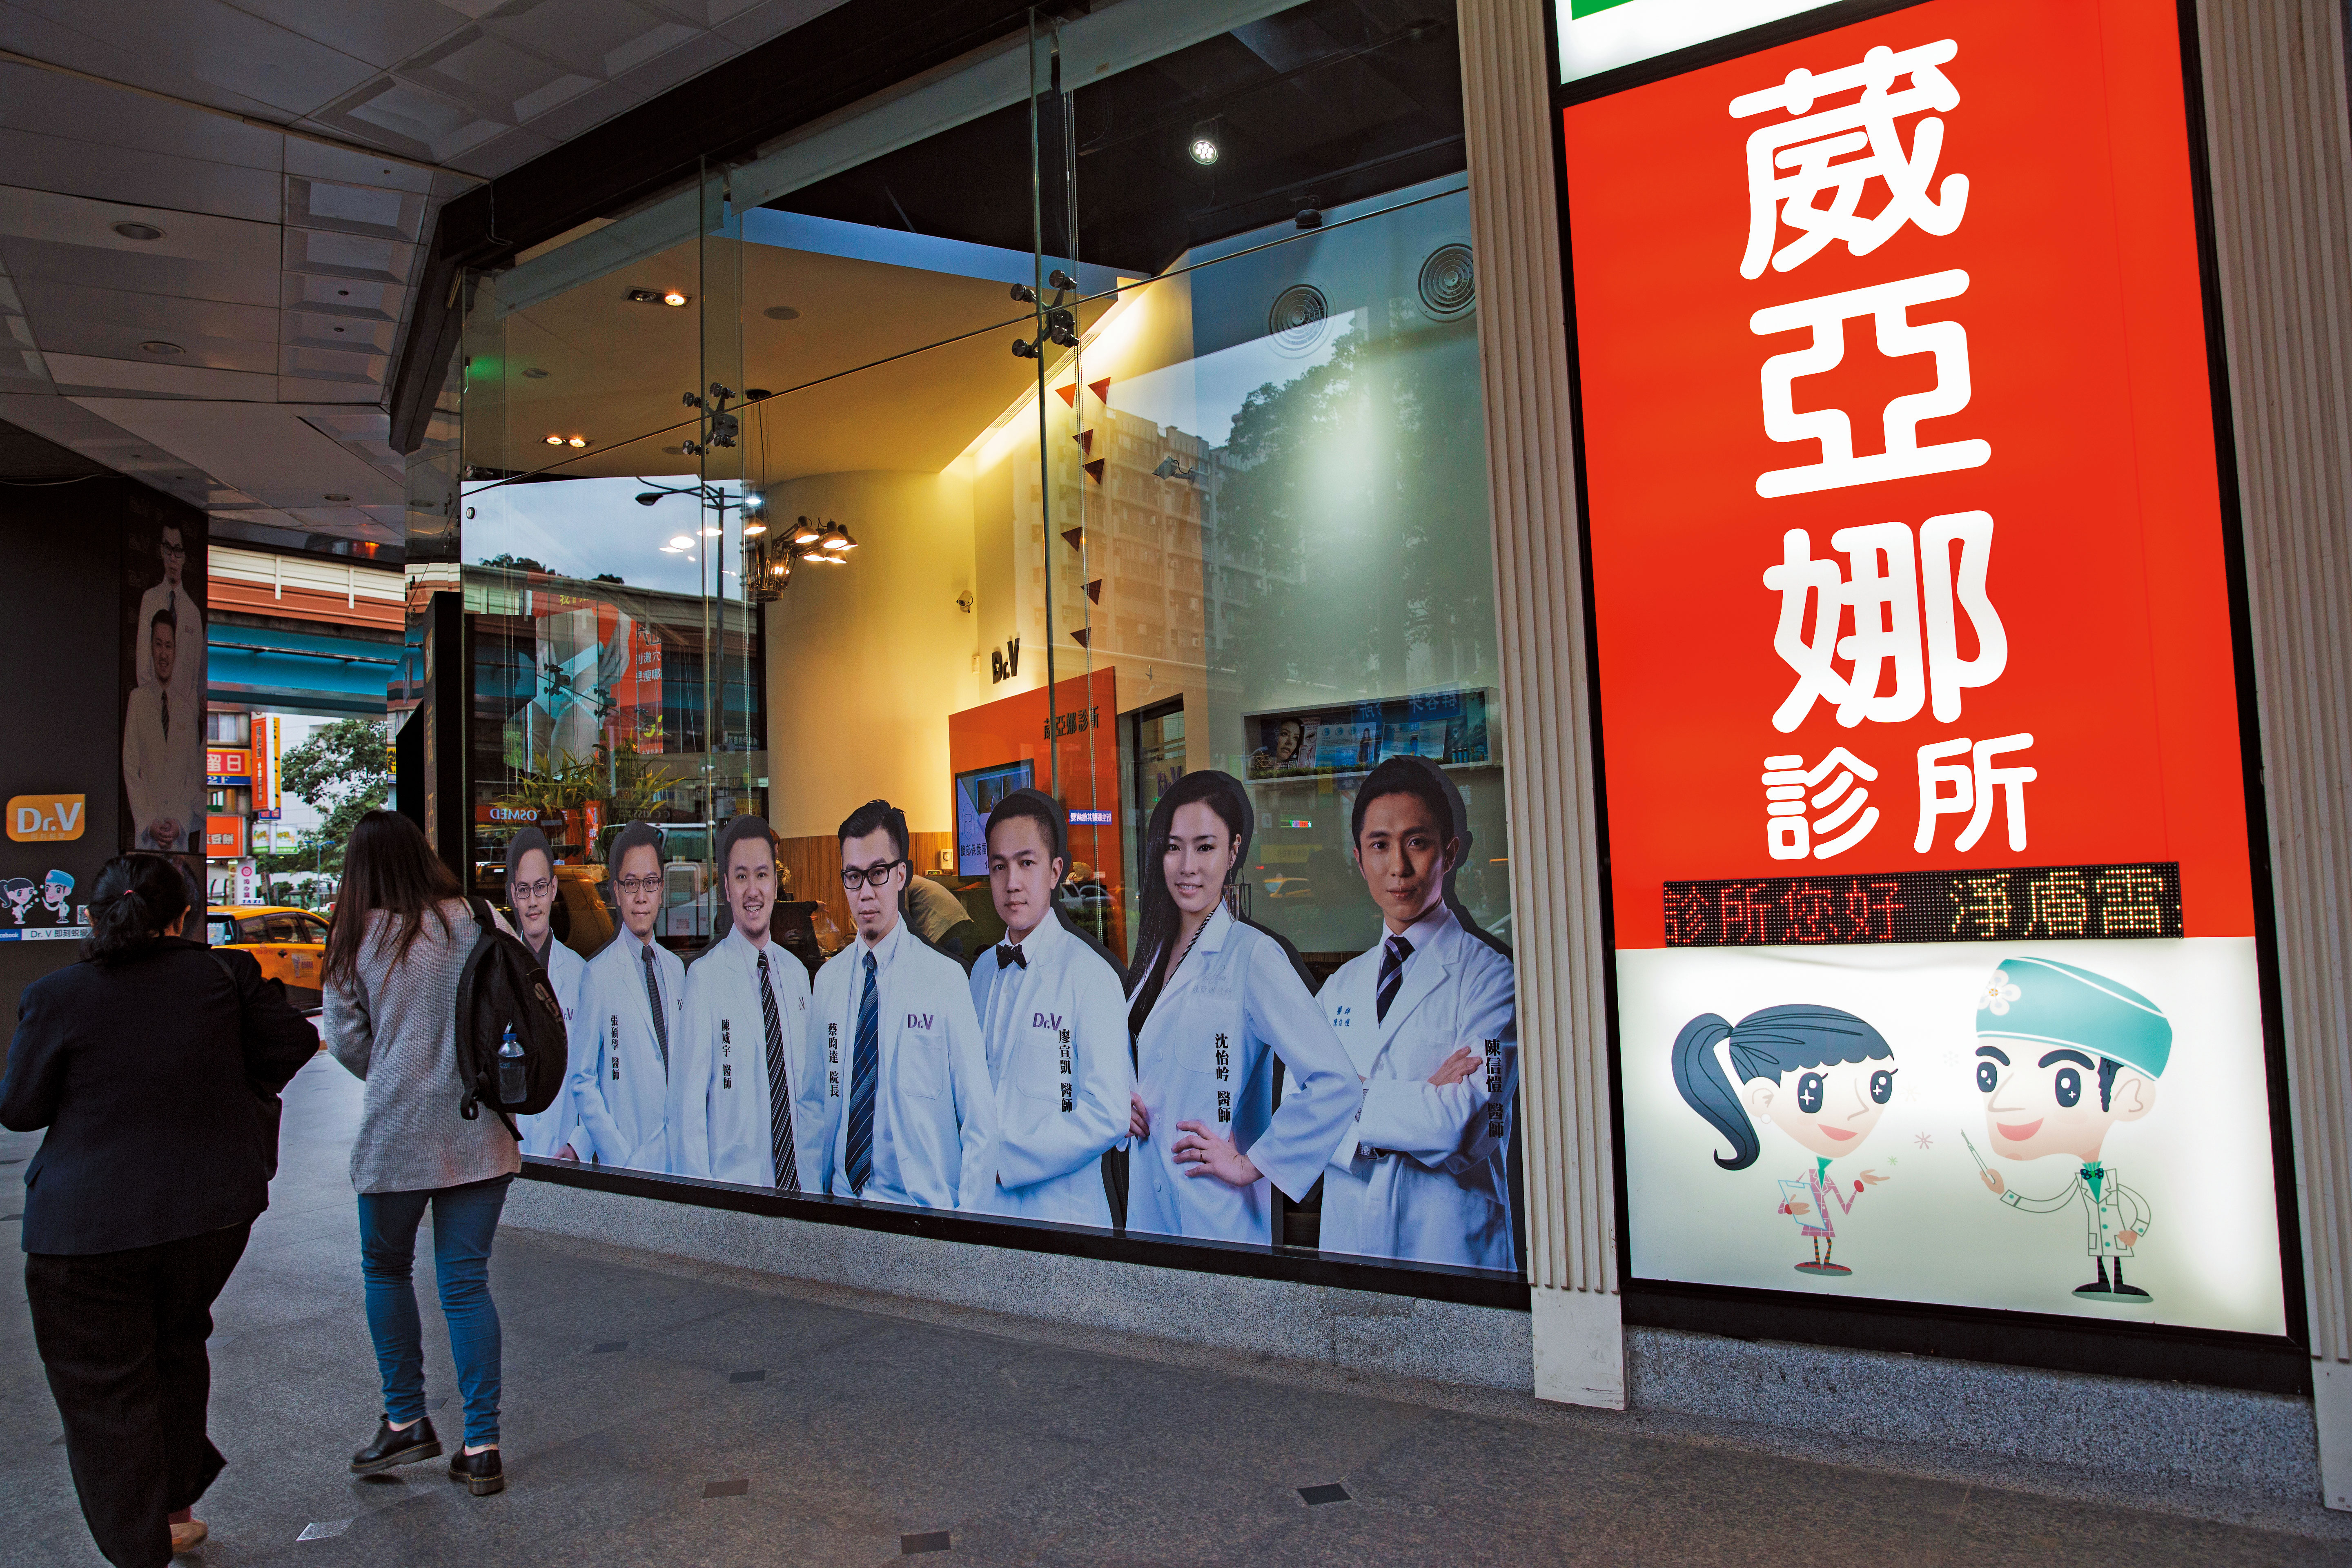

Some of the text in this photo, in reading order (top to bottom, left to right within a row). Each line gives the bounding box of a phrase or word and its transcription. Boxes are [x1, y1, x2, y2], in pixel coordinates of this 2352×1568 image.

[1728, 38, 2008, 733] 葳亞娜
[992, 638, 1020, 684] Dr.V
[18, 802, 82, 833] Dr.V
[1761, 733, 2037, 860] 診所
[908, 1013, 934, 1030] Dr.V
[1033, 1013, 1062, 1031] Dr.V
[612, 1057, 619, 1080] 醫師
[722, 1019, 731, 1089] 陳威宇 醫師
[828, 1023, 840, 1098] 蔡昀達 院長
[1059, 1029, 1073, 1113] 廖宣凱 醫師
[1217, 1090, 1231, 1123] 醫師
[1484, 1039, 1504, 1138] 陳信愷 醫師
